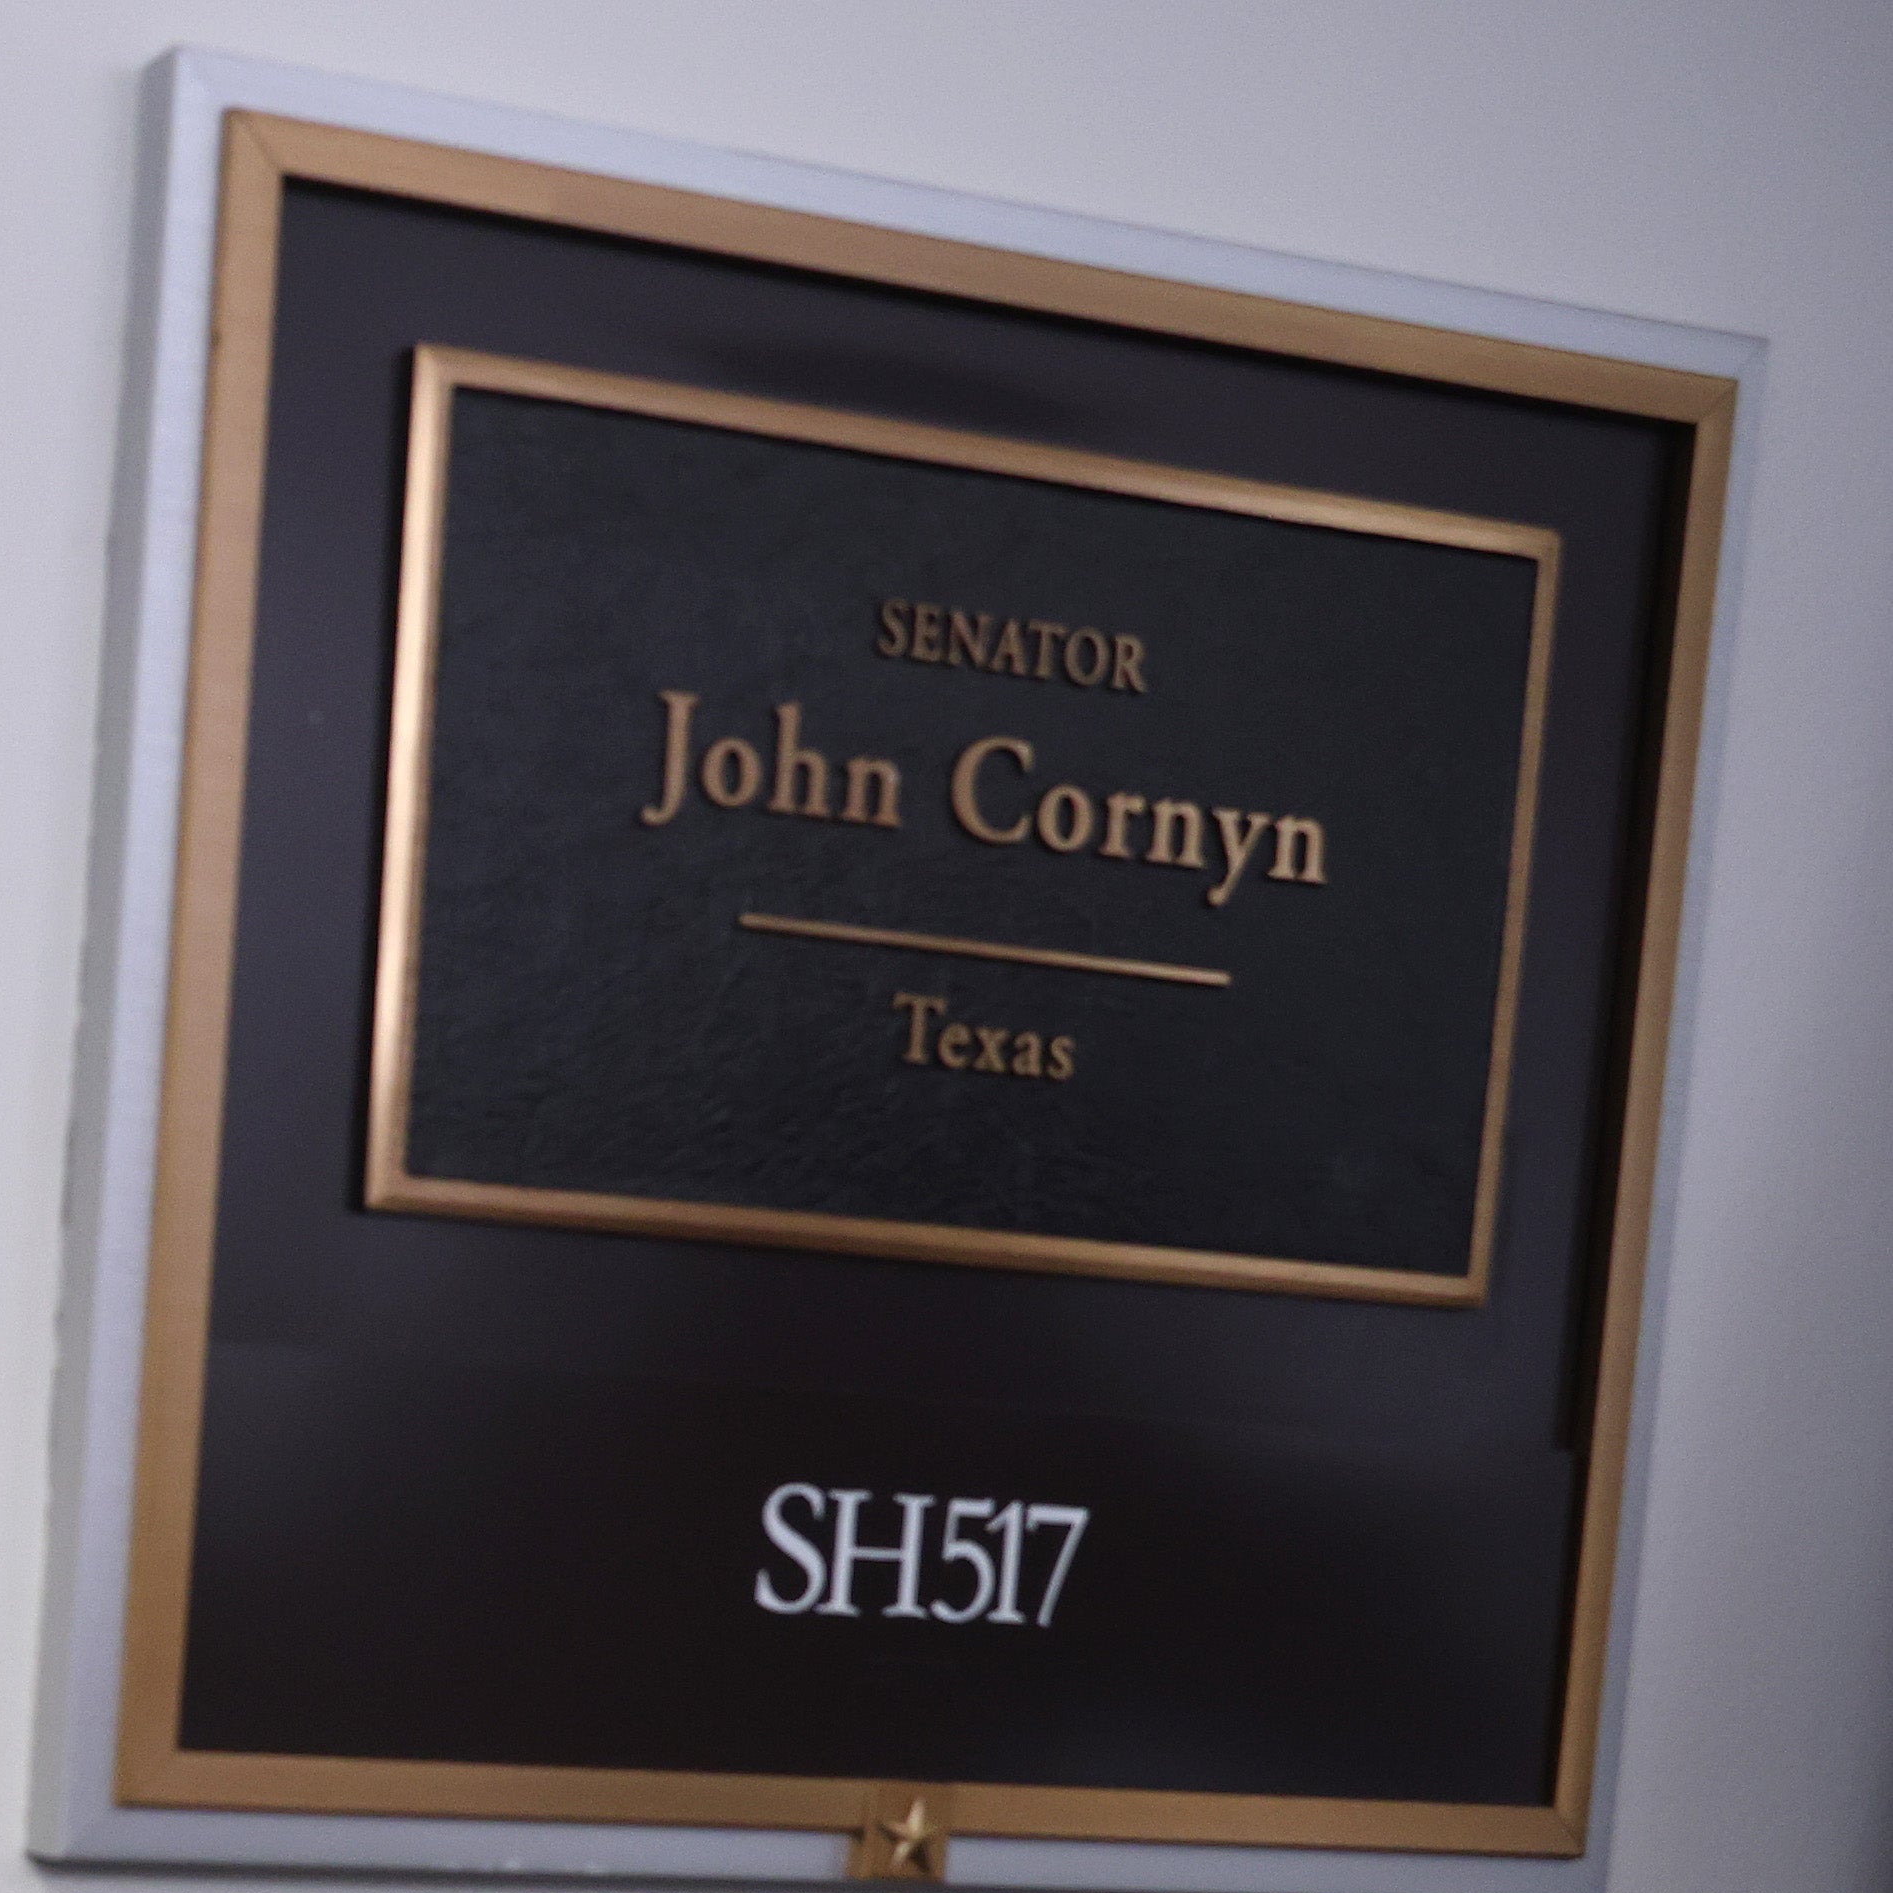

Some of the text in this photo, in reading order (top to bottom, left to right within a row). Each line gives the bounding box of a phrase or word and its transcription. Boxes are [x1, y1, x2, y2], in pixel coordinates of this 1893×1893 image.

[875, 600, 1148, 694] SENATOR
[641, 690, 1329, 907] John Cornyn
[893, 992, 1077, 1080] Texas
[753, 1481, 1091, 1629] SH517
